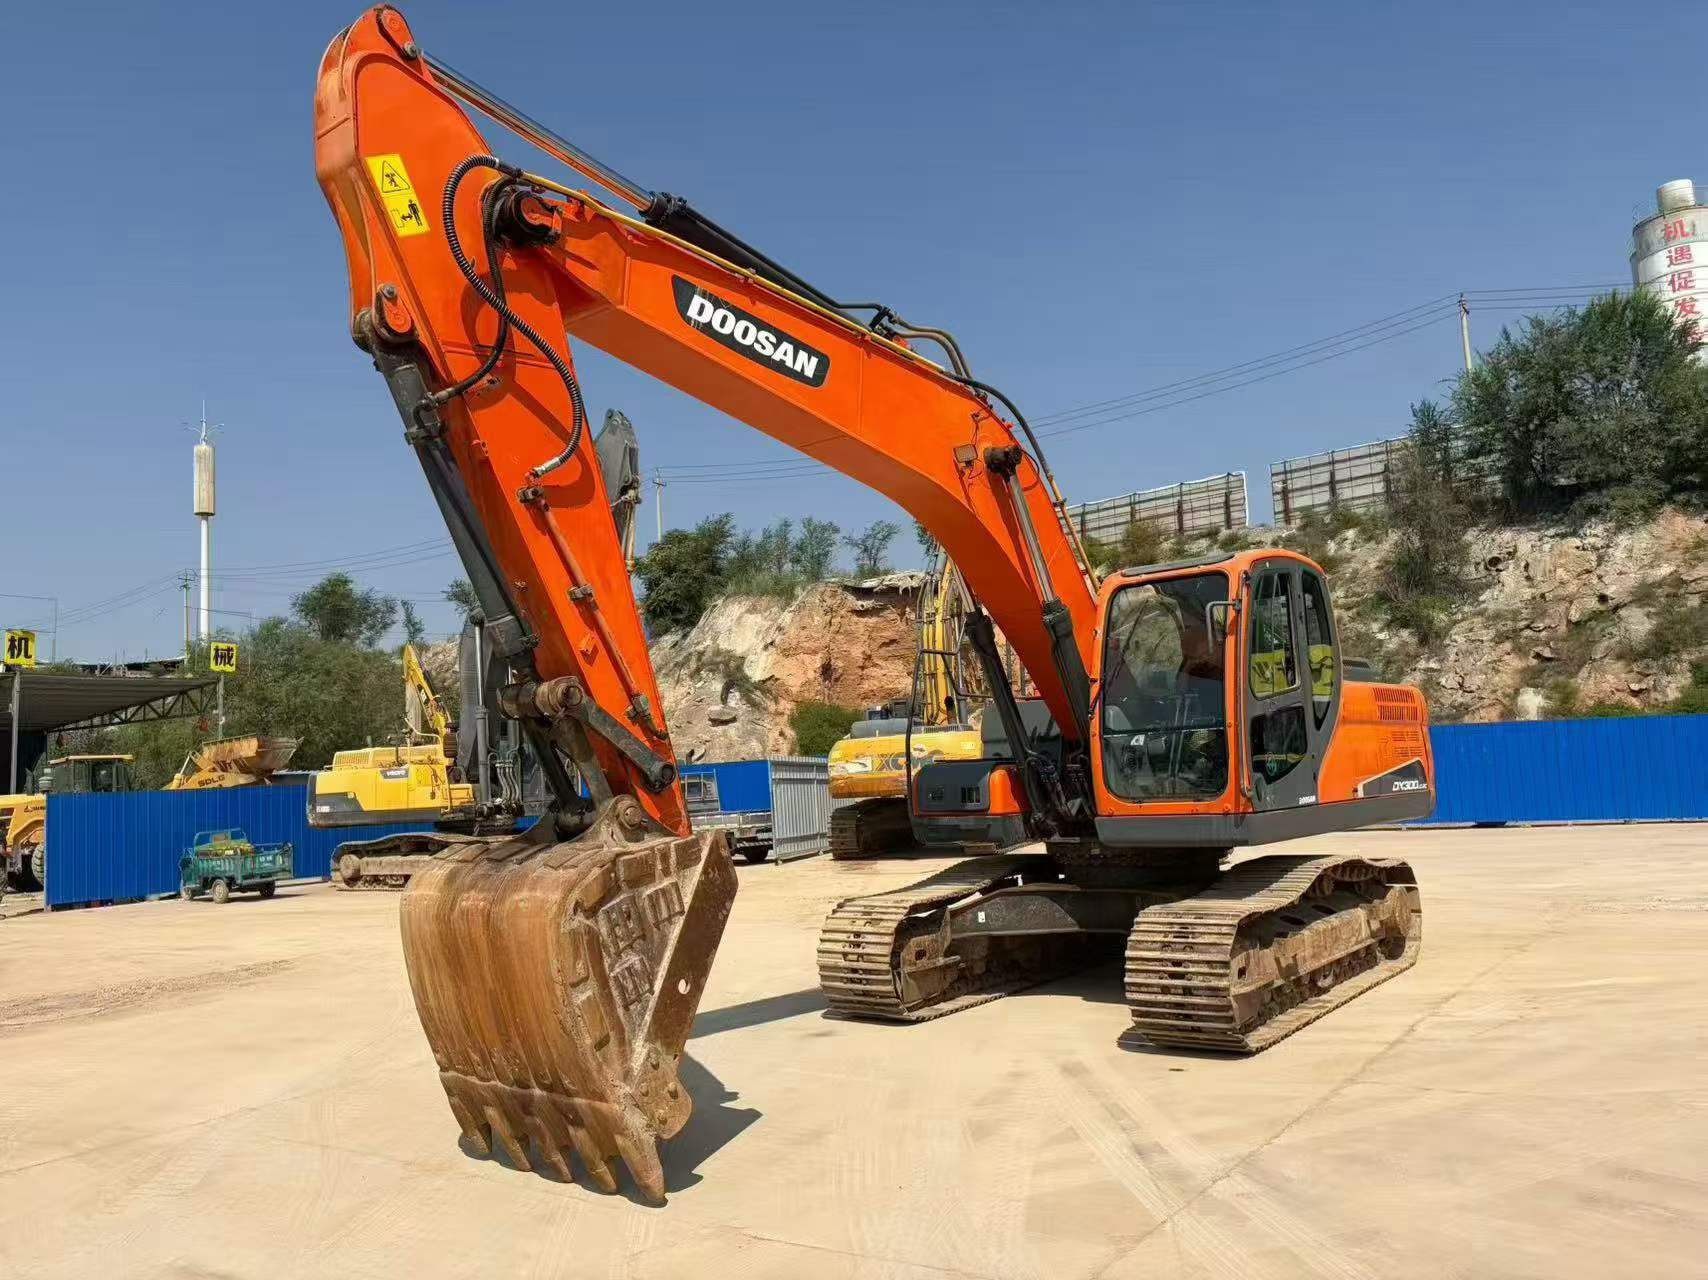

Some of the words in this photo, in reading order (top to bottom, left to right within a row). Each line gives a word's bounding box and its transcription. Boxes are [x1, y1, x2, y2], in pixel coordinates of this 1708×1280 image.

[1663, 218, 1704, 343] 机遇促发
[686, 294, 819, 379] DOOSAN
[7, 635, 33, 659] 机
[213, 645, 235, 667] 械
